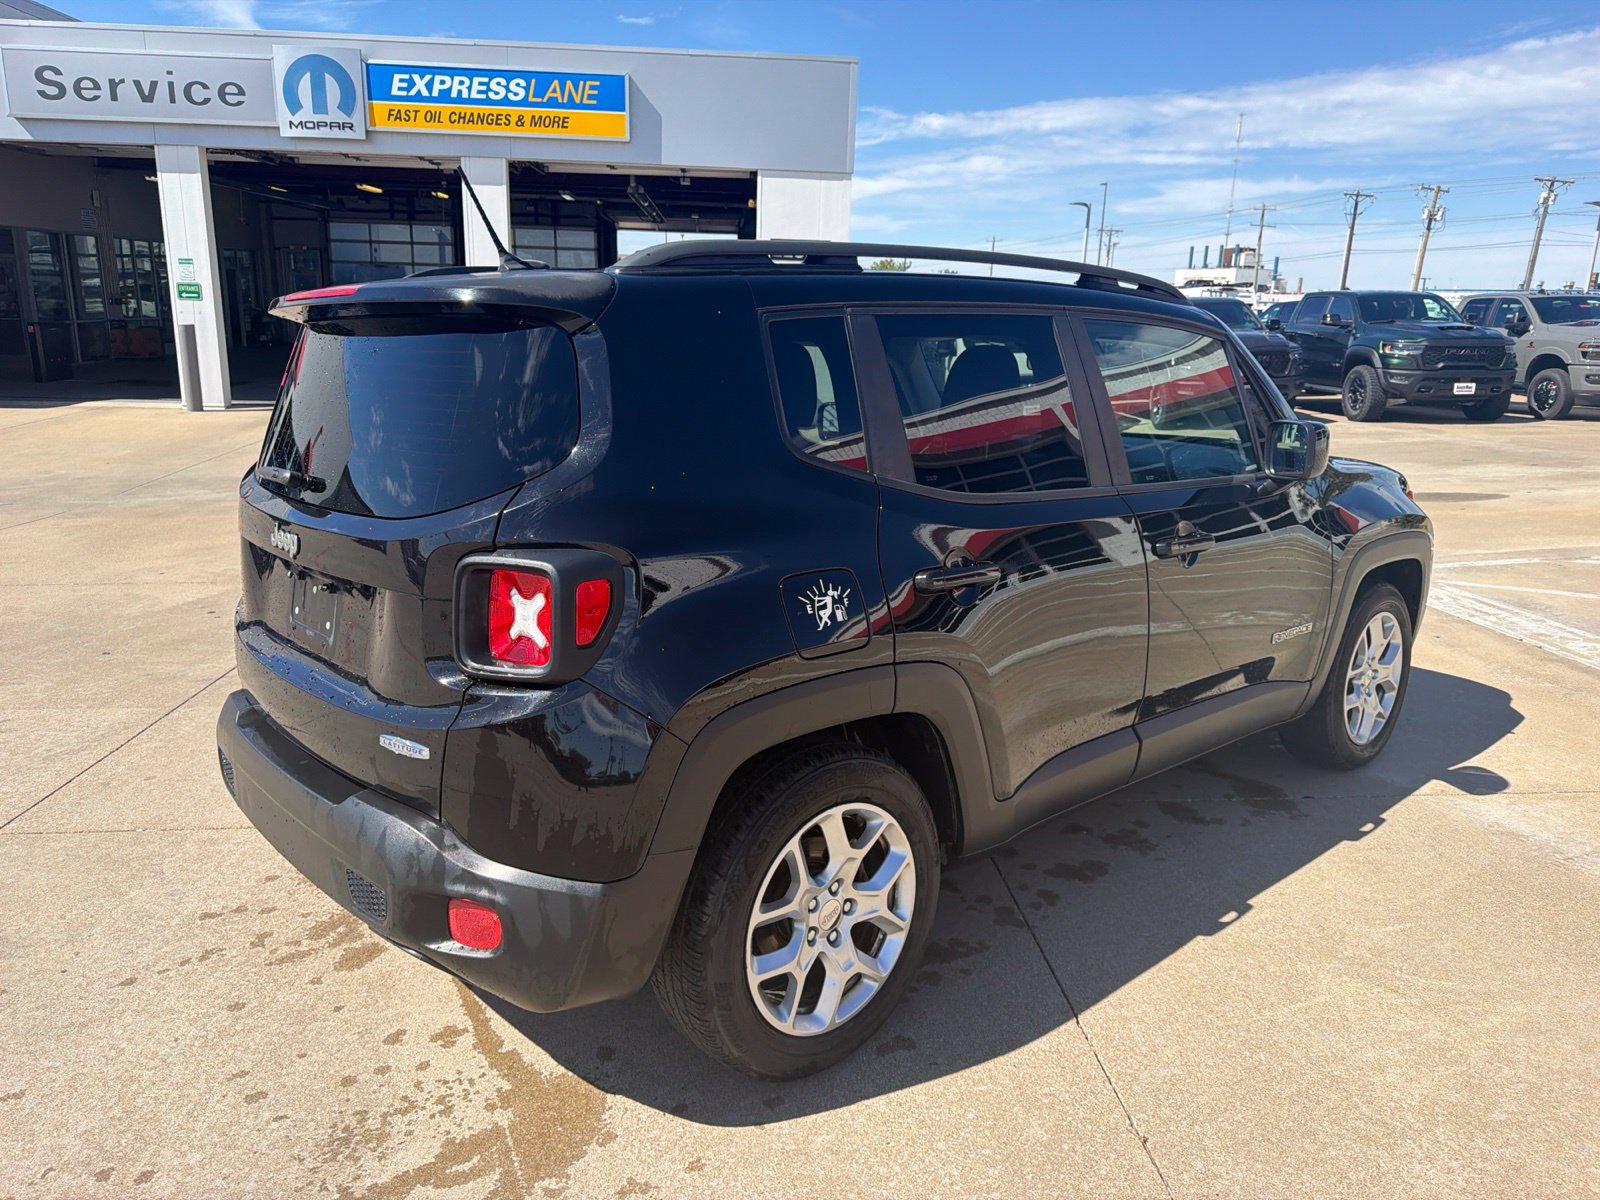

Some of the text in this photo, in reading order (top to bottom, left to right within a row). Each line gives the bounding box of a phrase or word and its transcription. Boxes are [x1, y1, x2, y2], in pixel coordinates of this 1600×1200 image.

[34, 64, 247, 107] Service
[288, 120, 354, 132] MOPAR
[387, 108, 570, 129] FAST OIL CHANGES & MORE
[270, 522, 299, 558] Jeep
[807, 605, 813, 614] E
[844, 598, 849, 607] F
[382, 738, 426, 757] LATITUDE
